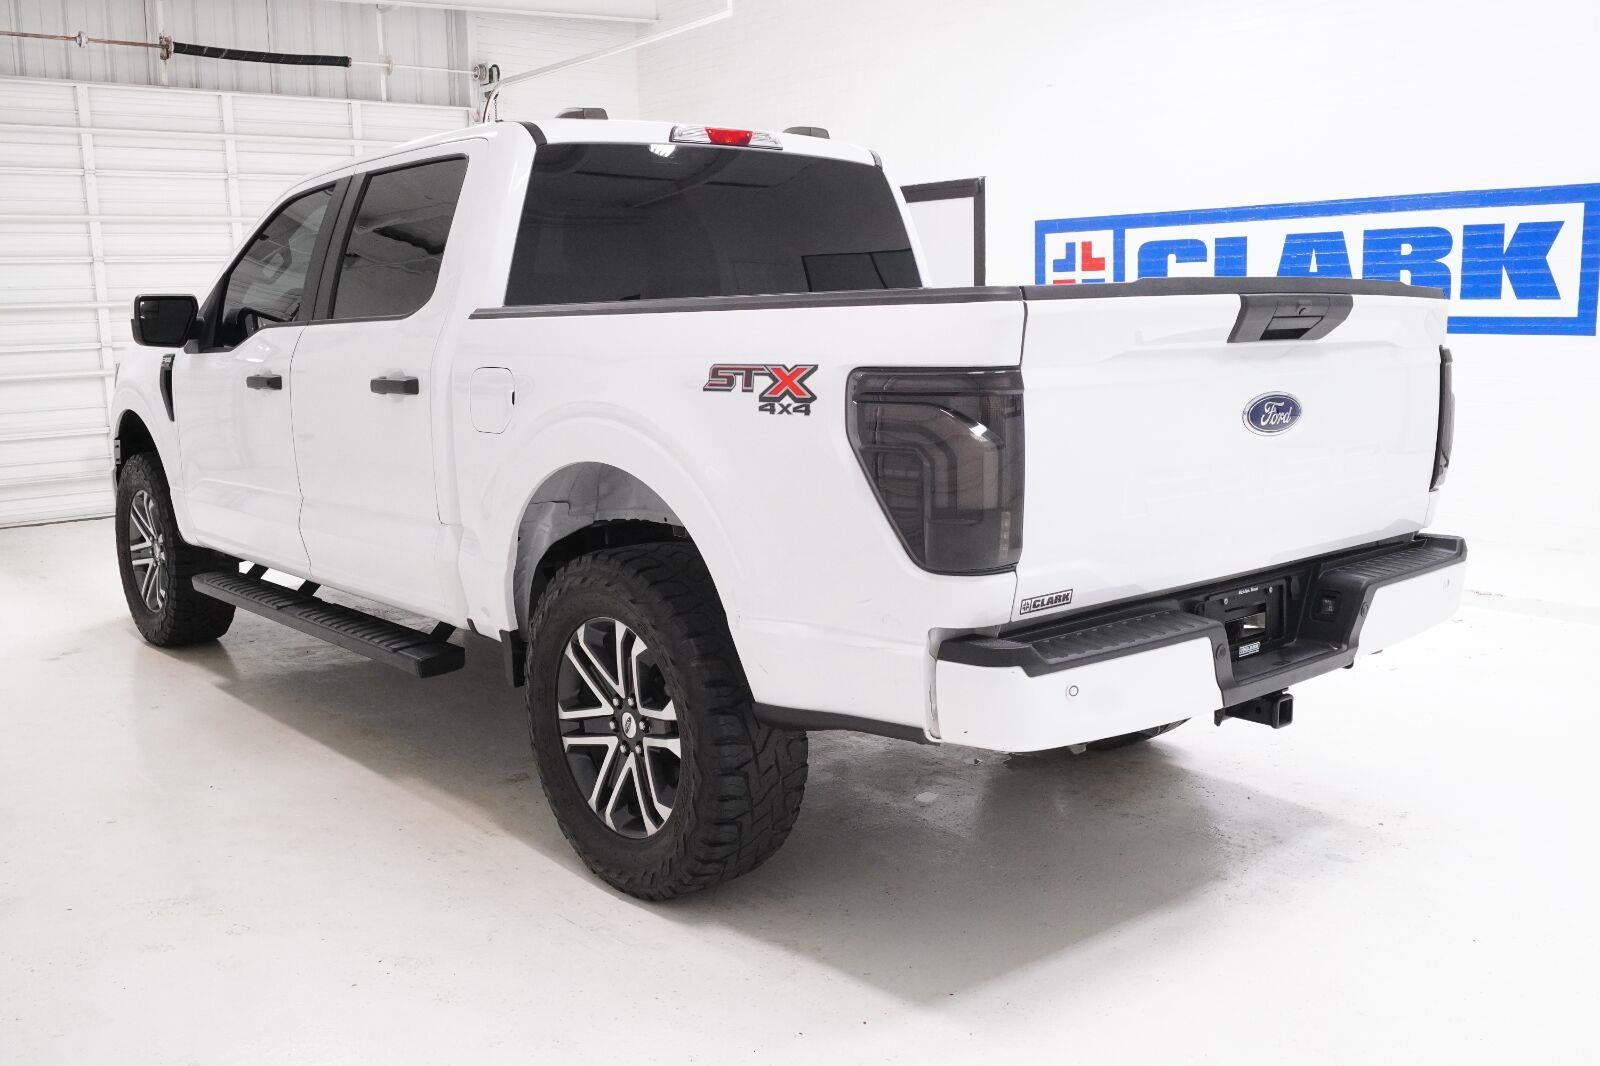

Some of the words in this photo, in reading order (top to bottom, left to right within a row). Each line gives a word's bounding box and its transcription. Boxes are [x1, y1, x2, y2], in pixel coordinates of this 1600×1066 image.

[1138, 221, 1566, 300] CLARK
[703, 363, 819, 403] STX
[1260, 401, 1292, 426] Ford
[1032, 592, 1071, 609] CLARK
